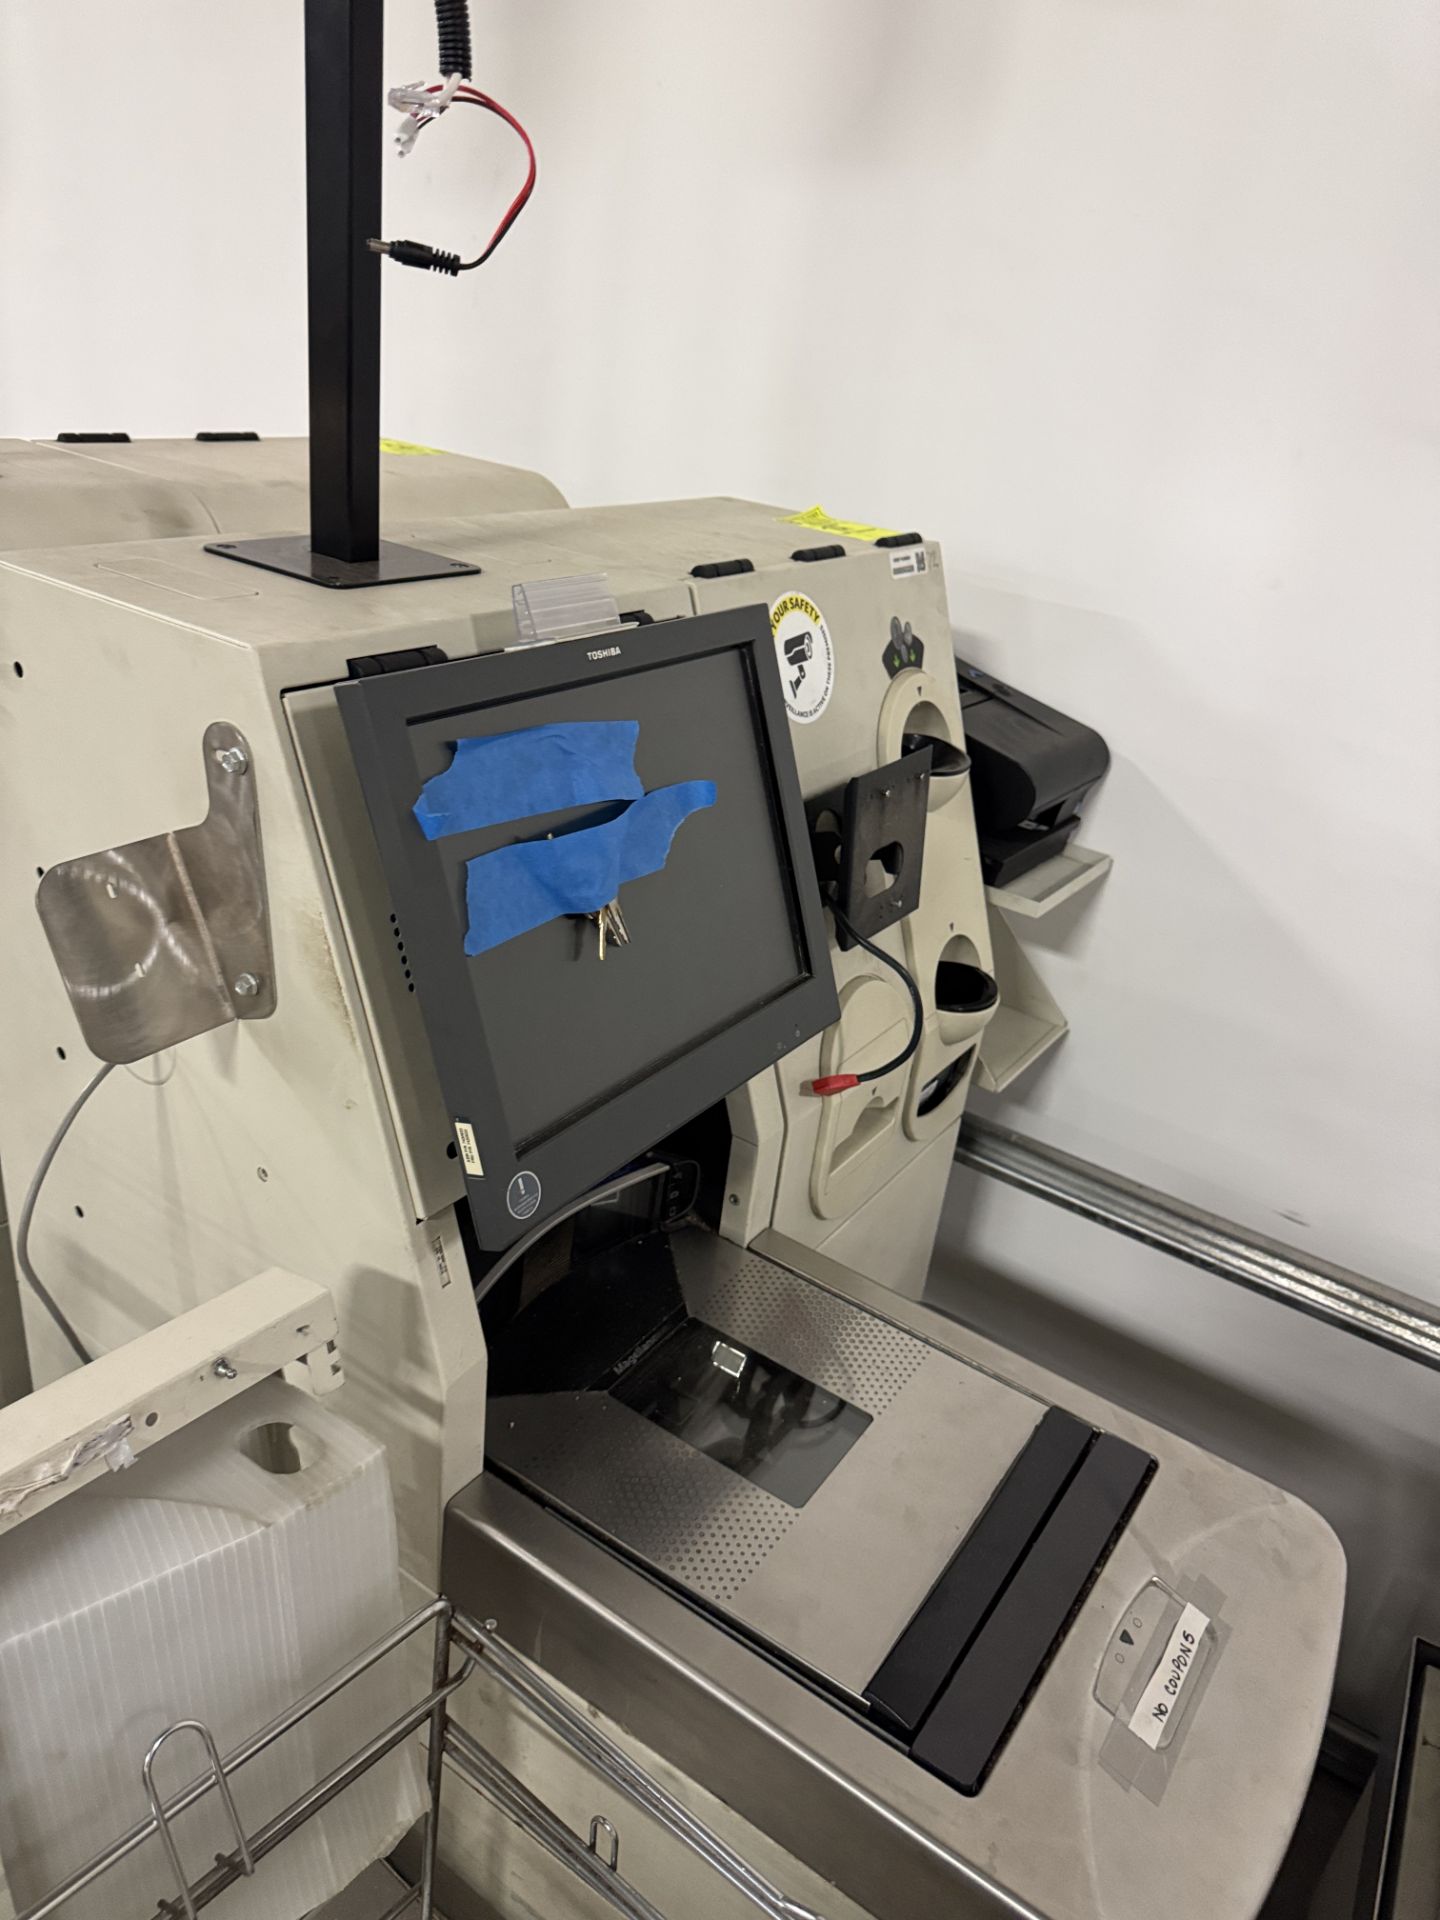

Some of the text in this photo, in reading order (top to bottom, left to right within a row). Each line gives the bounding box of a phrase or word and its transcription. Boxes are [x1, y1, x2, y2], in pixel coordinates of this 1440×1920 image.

[789, 597, 820, 622] SAFETY
[586, 646, 622, 661] TOSHIBA
[1152, 1630, 1196, 1724] NO COUPONS
